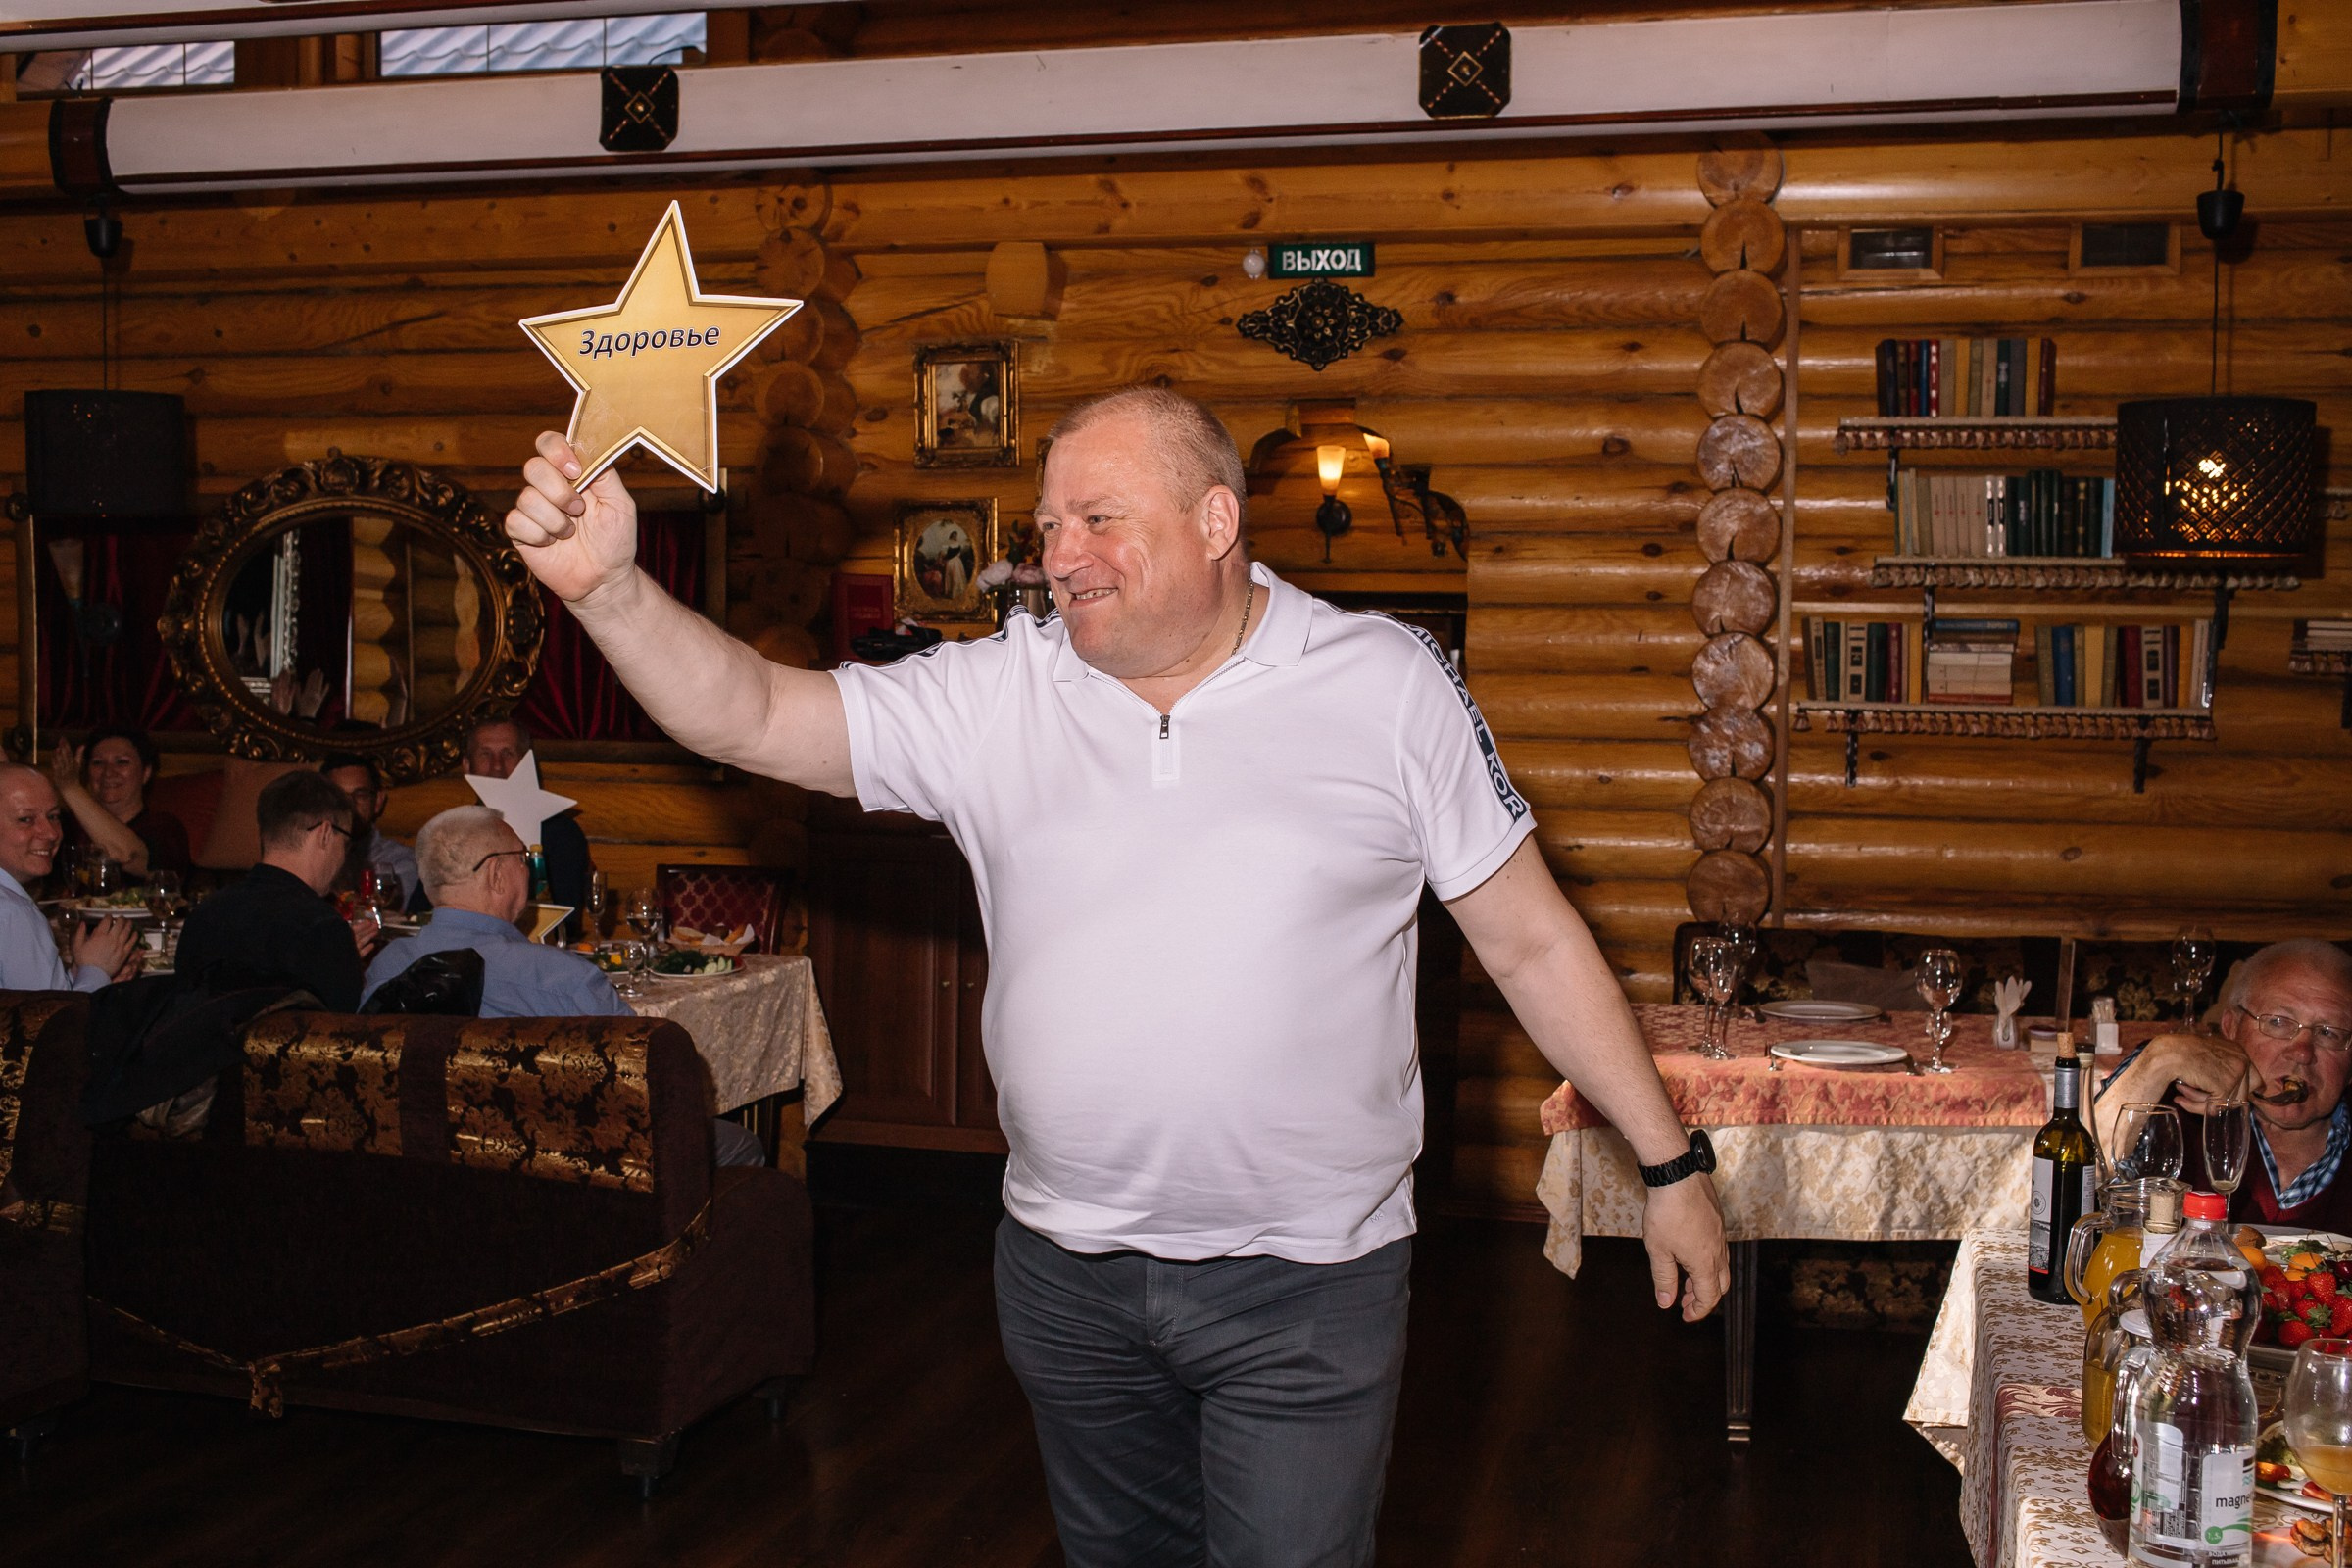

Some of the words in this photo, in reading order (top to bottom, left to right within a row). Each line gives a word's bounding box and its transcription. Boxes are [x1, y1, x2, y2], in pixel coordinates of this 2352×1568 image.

[1282, 249, 1361, 271] ВЫХОД
[579, 326, 720, 359] Здоровье
[1405, 624, 1485, 742] MICHAEL
[1486, 753, 1525, 821] KOR
